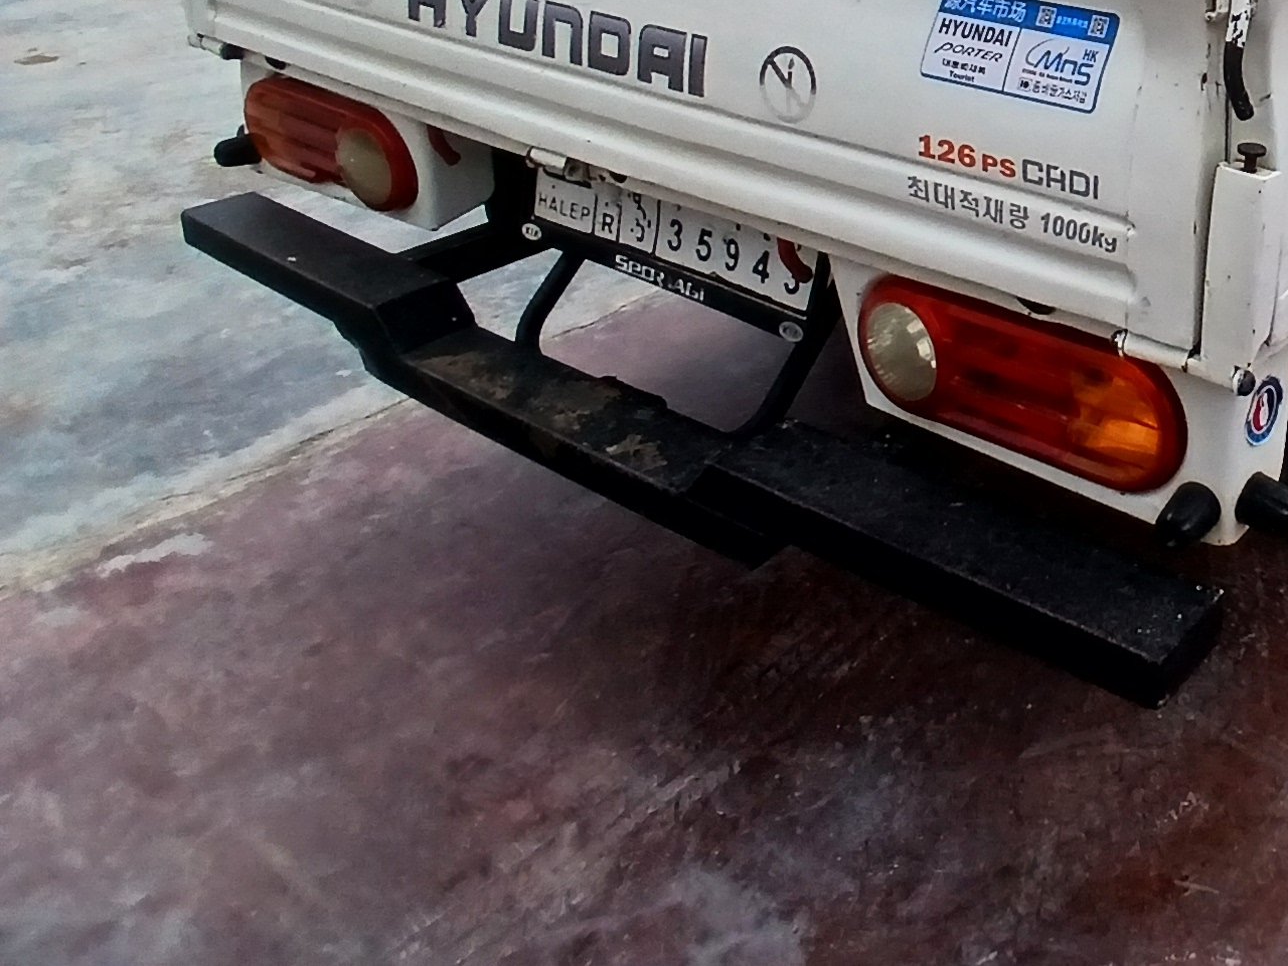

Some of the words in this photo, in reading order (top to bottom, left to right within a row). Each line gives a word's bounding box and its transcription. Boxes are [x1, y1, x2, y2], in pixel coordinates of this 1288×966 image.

[938, 17, 1013, 48] HYUNDAI
[934, 42, 1003, 63] PORTER
[1082, 48, 1099, 63] HK
[949, 70, 975, 83] Tourist
[537, 192, 591, 222] HALEP
[601, 213, 615, 235] R
[907, 175, 1030, 231] 최대적재량
